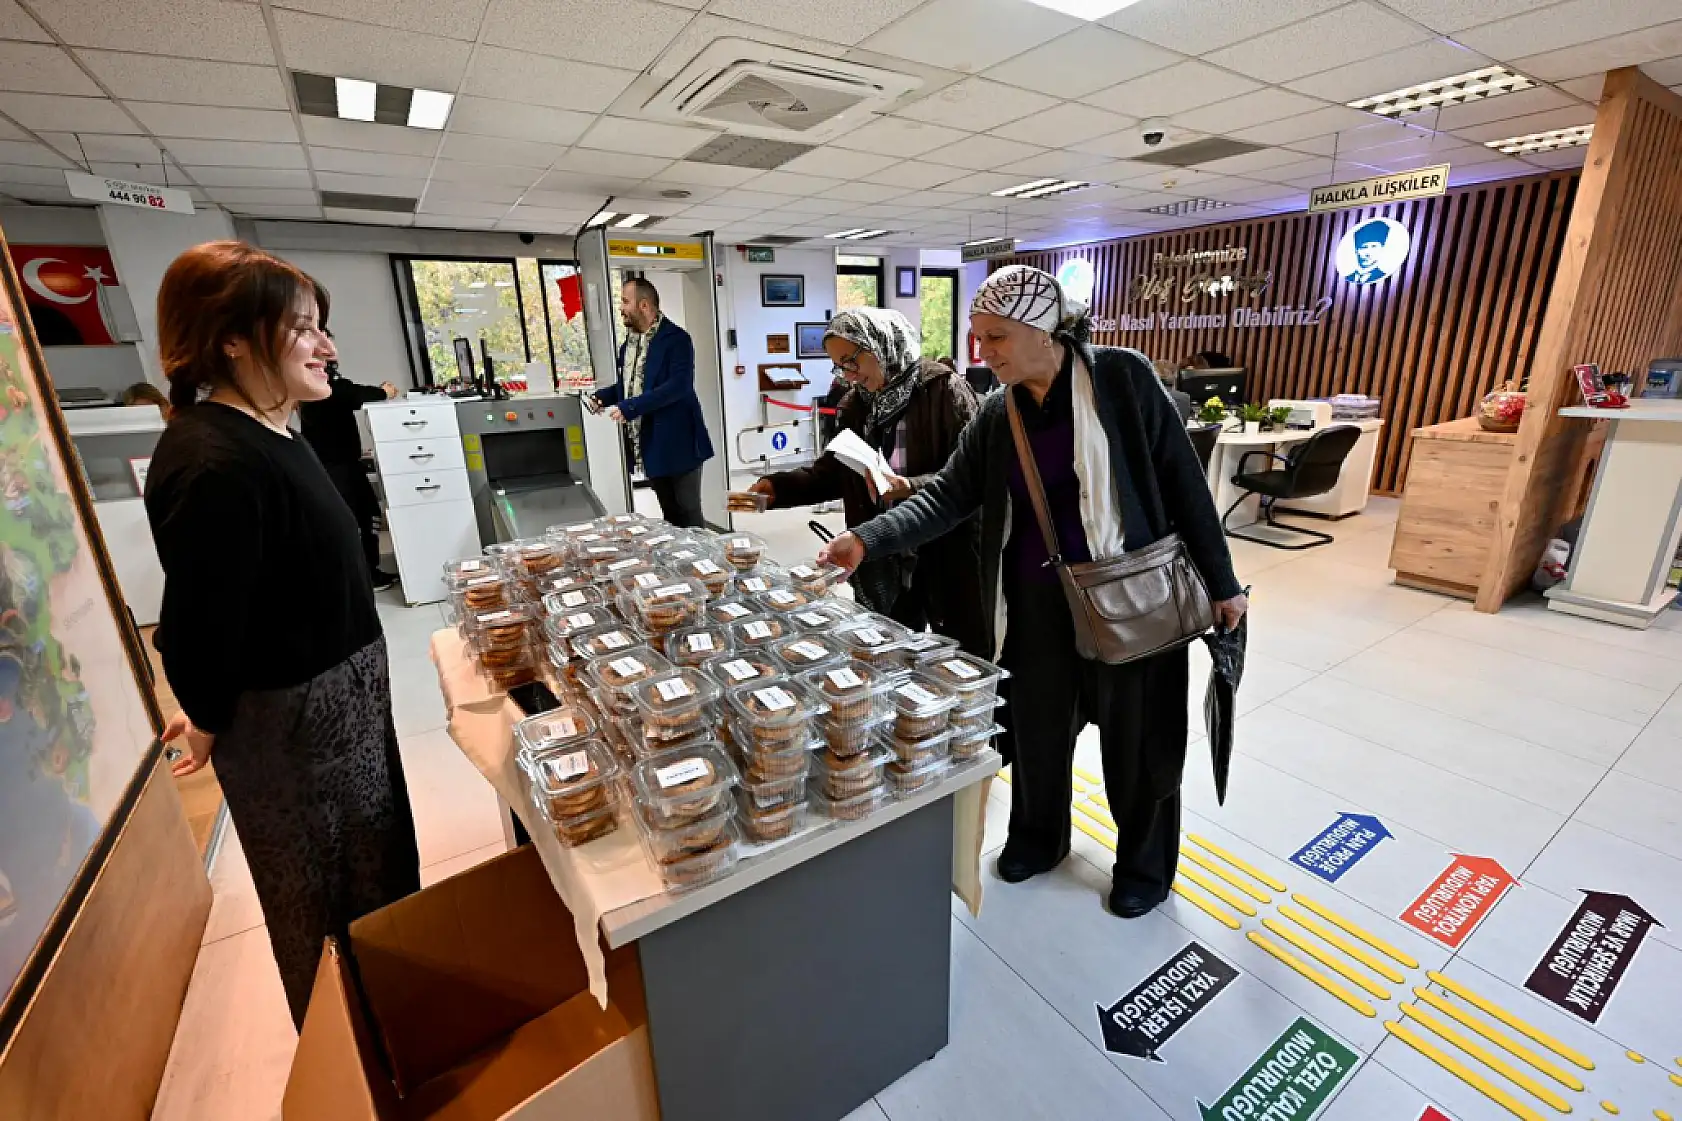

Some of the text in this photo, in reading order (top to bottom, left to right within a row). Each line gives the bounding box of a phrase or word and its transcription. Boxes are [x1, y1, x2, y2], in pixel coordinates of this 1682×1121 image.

[109, 190, 131, 202] 444
[1313, 174, 1441, 206] HALKLA İLİŞKİLER
[1089, 296, 1333, 332] Size Nasıl Yardımcı Olabiliriz?
[1413, 865, 1476, 924] MÜDÜRLÜĞÜ
[1432, 873, 1500, 937] YAPI KONTROL
[1547, 909, 1606, 980] MÜDÜRLÜĞÜ
[1565, 909, 1647, 1011] İMAR VE ŞEHİRCİLİK
[1112, 950, 1205, 1031] MÜDÜRLÜĞÜ
[1138, 971, 1219, 1043] YAZI İŞLERİ
[1293, 1051, 1343, 1093] ÖZEL
